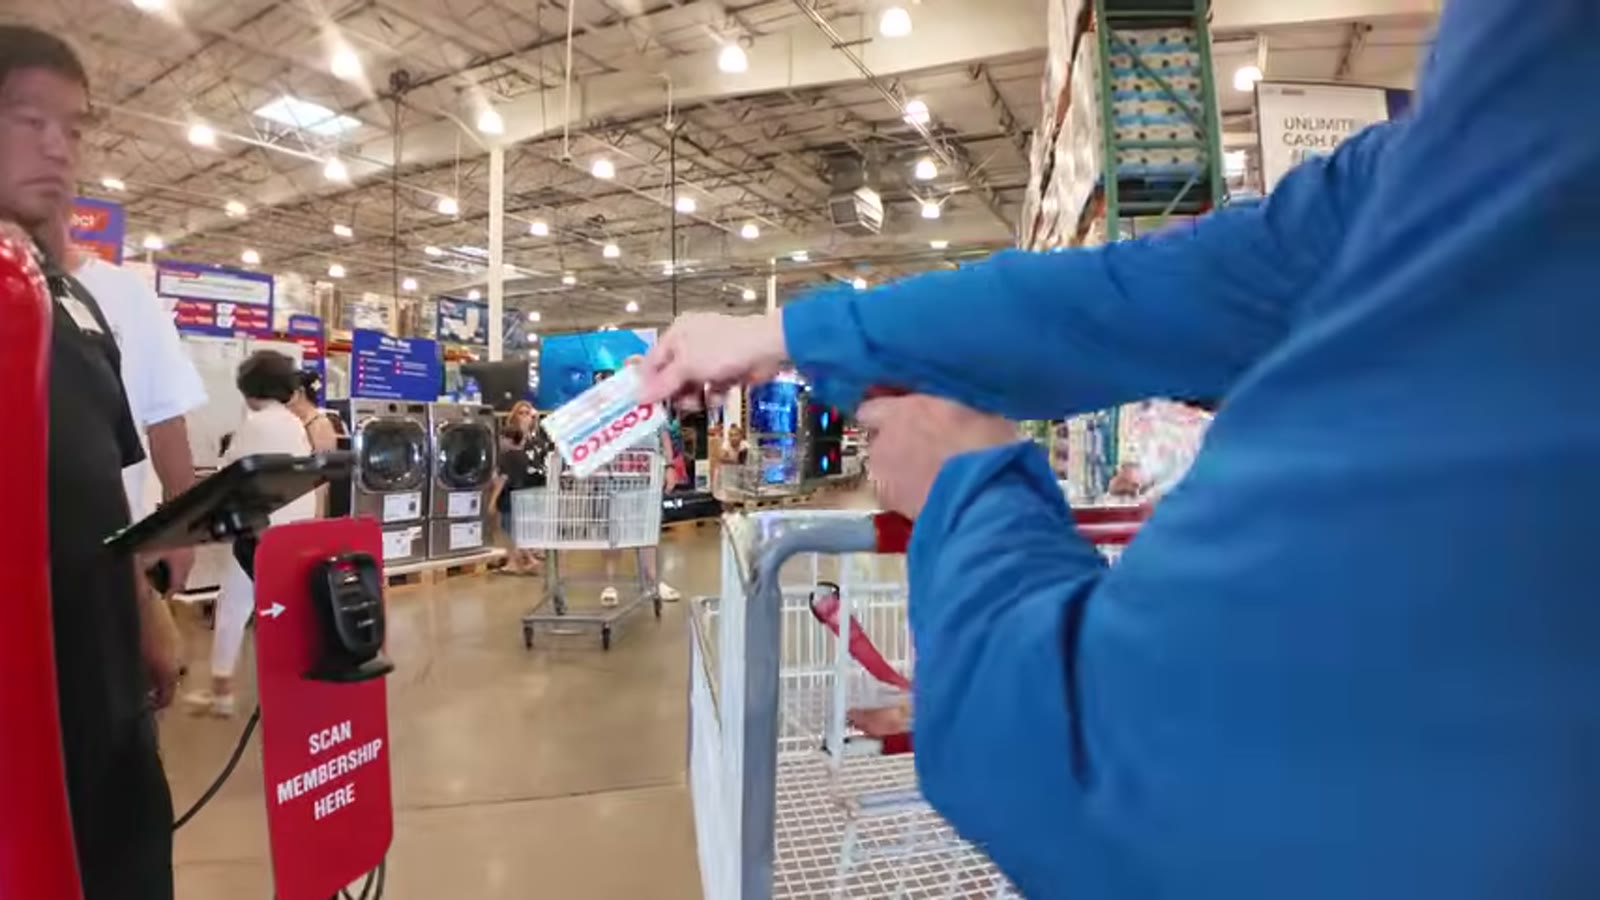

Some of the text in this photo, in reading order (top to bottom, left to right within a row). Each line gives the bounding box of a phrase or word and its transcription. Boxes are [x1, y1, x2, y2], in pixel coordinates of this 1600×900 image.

[1282, 132, 1326, 147] CASH
[572, 401, 655, 464] COSTCO
[308, 719, 352, 755] SCAN
[276, 737, 383, 805] MEMBERSHIP
[313, 782, 356, 821] HERE
